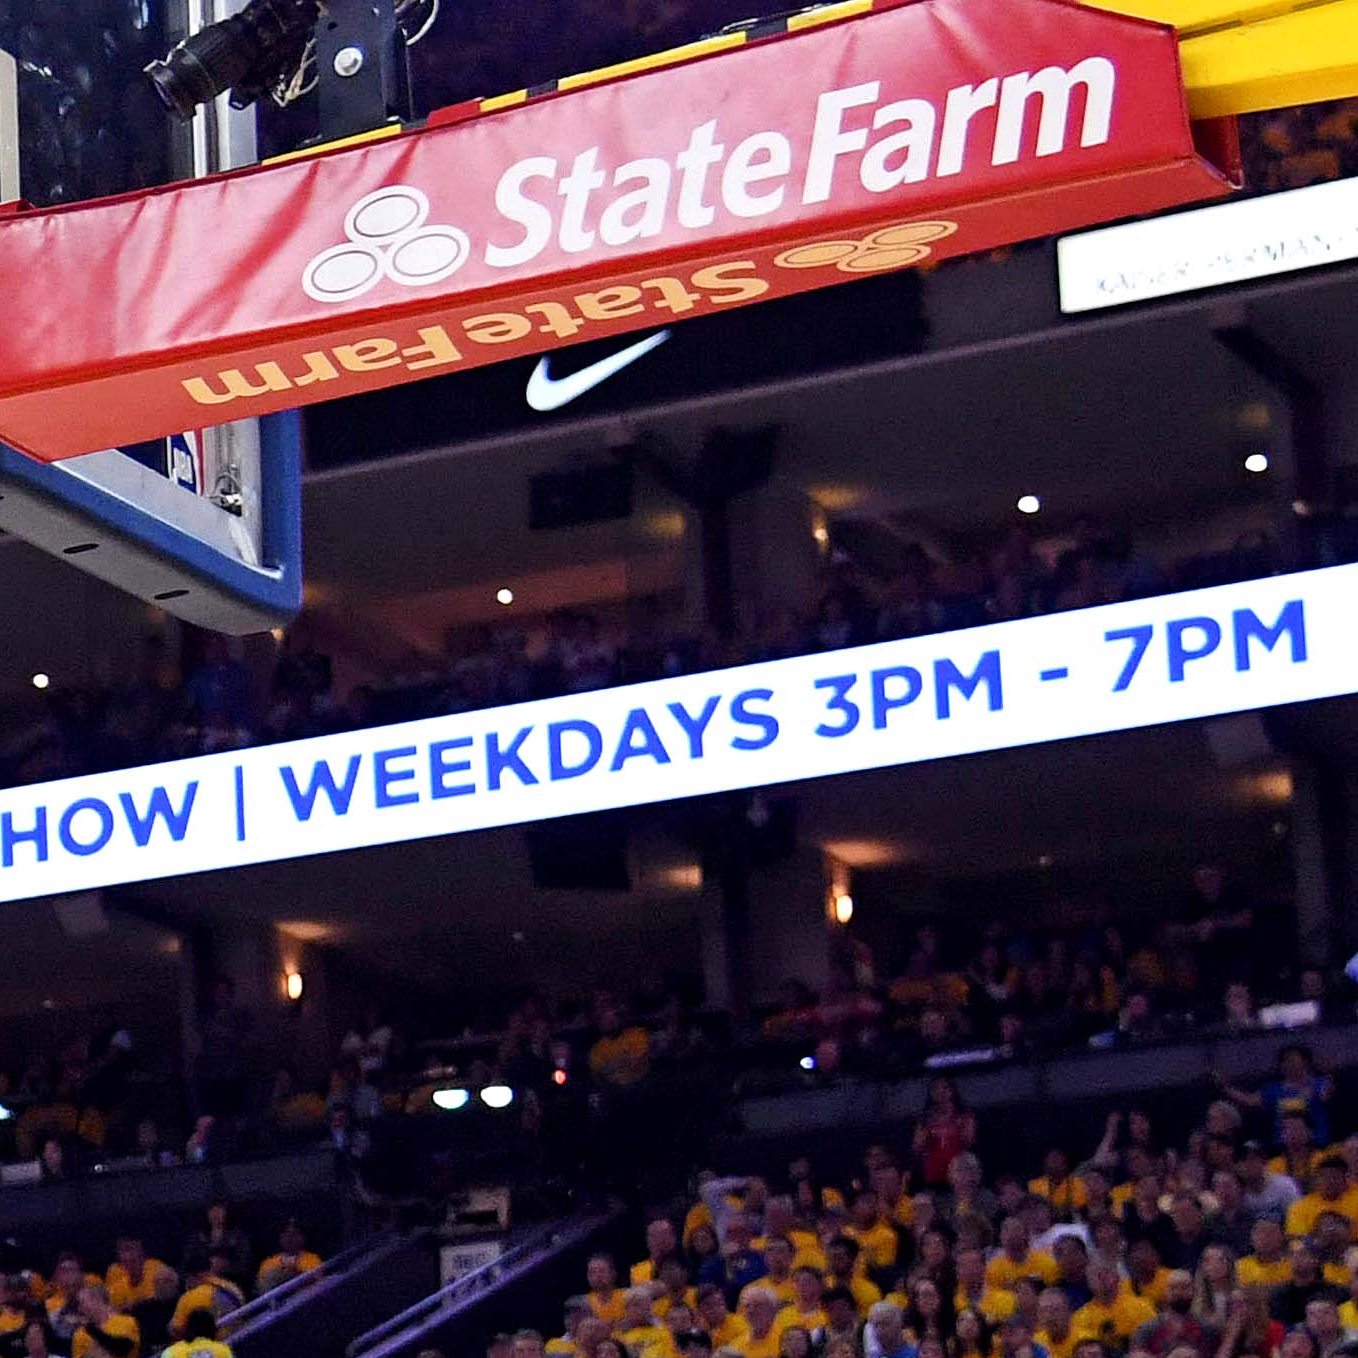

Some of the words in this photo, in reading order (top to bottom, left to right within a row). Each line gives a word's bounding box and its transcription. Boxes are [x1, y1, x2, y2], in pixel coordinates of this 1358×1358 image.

[278, 688, 780, 825] WEEKDAYS
[812, 649, 1004, 739] 3PM
[1103, 599, 1308, 693] 7PM
